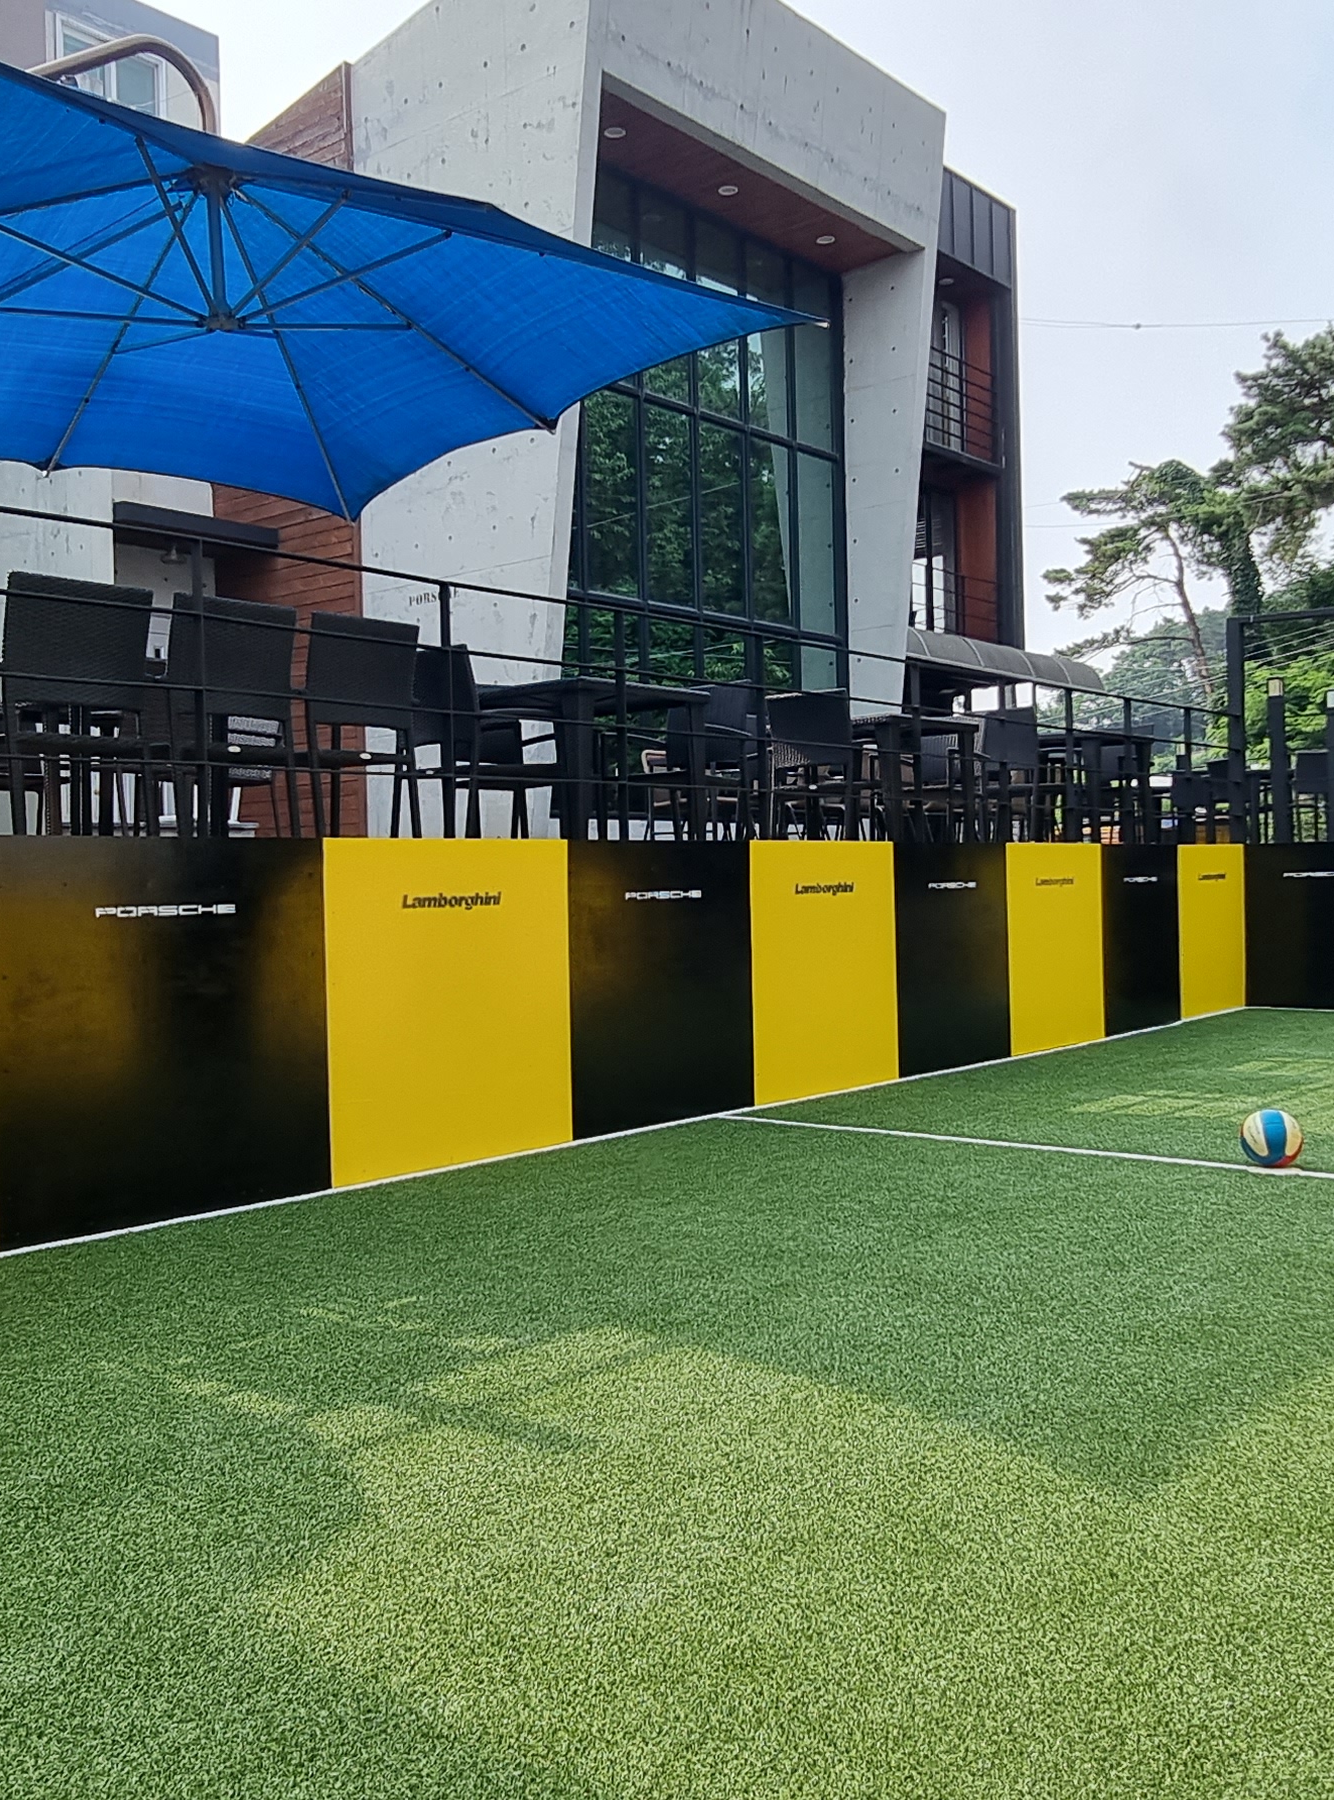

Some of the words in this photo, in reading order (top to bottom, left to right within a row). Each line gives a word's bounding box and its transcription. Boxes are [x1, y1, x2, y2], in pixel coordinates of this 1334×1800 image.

[408, 587, 461, 607] PORSE
[94, 903, 237, 919] PORSCHE
[401, 891, 502, 911] Lamborghini
